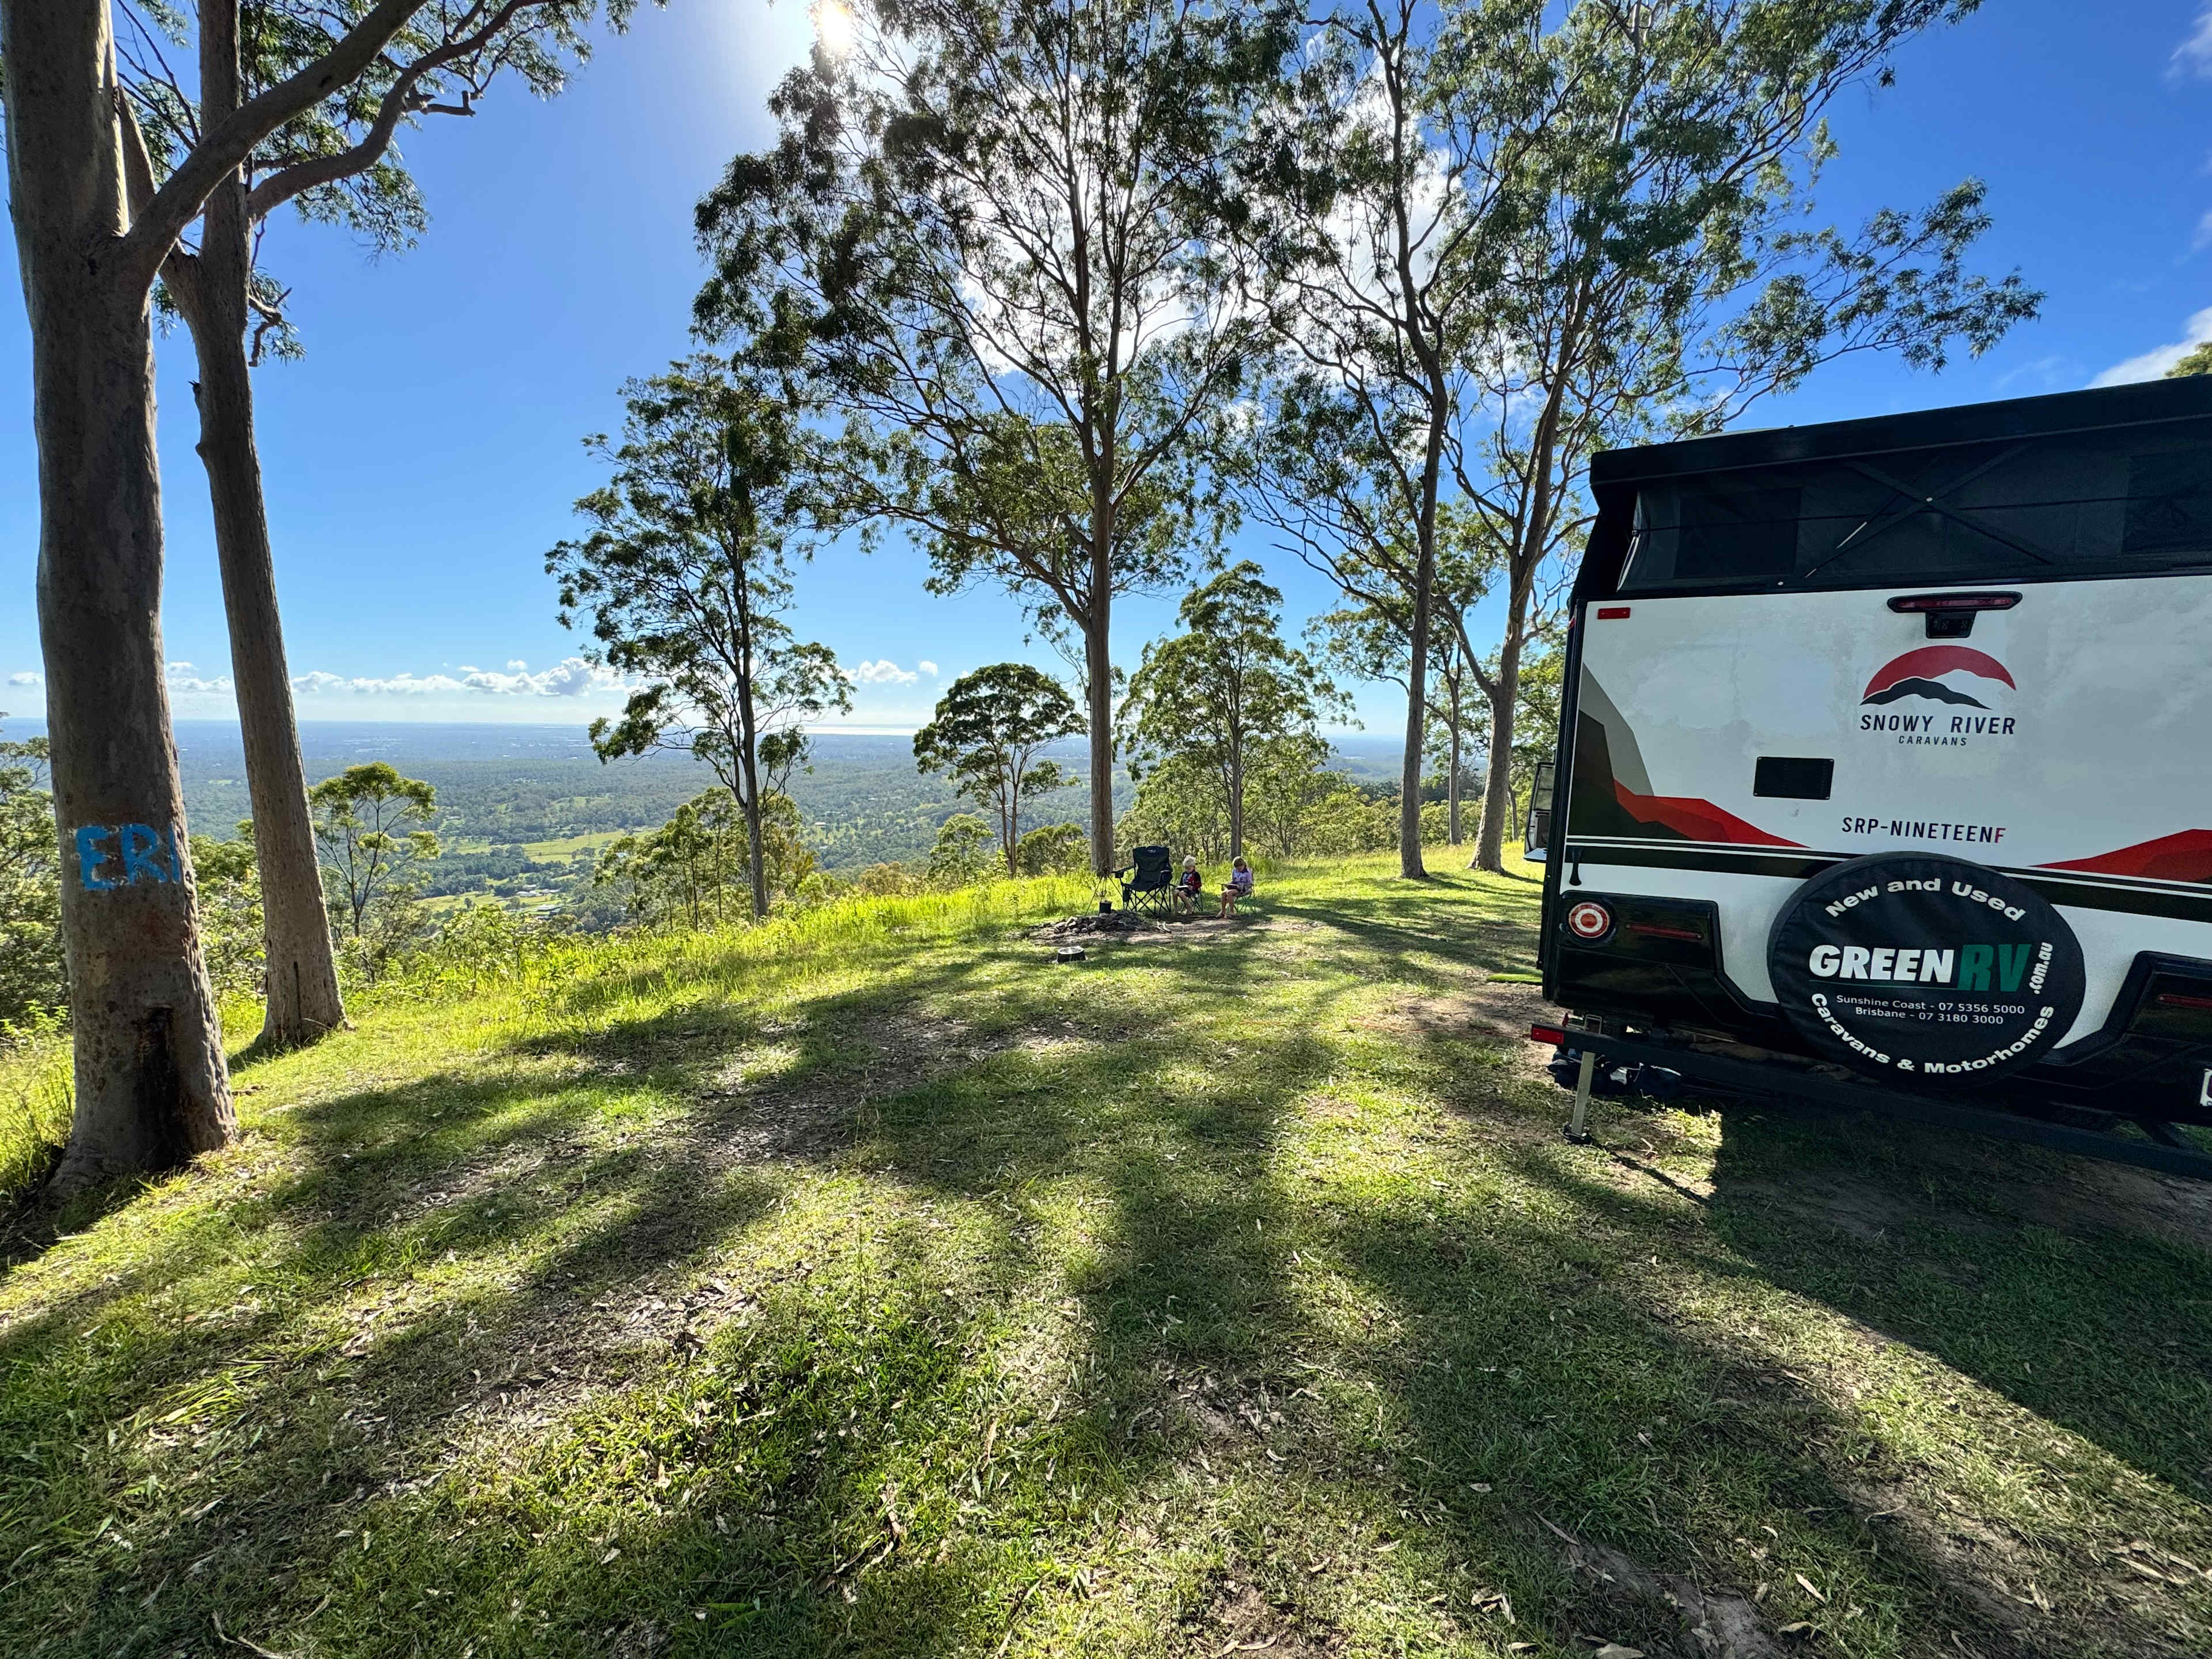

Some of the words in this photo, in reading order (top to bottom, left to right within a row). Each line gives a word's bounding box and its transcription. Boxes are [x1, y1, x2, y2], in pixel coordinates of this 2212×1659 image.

[1860, 714, 1934, 732] SNOWY
[1950, 716, 2016, 734] RIVER
[1899, 736, 1967, 746] CARAVANS
[1825, 885, 1878, 917] New
[1887, 878, 1941, 891] and
[1952, 881, 2027, 921] Used
[1836, 995, 1889, 1007] Sunshine
[1892, 1000, 1926, 1010] Coast
[1938, 1002, 1953, 1011] 07
[1958, 1003, 1989, 1012] 5356
[1993, 1005, 2025, 1014] 5000
[1855, 1007, 1906, 1018] Brisbane
[1919, 1012, 1934, 1020] 07
[1938, 1013, 1968, 1022] 3180
[1972, 1015, 2003, 1024] 3000
[1811, 993, 1891, 1063] Caravans
[1897, 1059, 1915, 1071] &
[1924, 1006, 2054, 1073] Motorhomes
